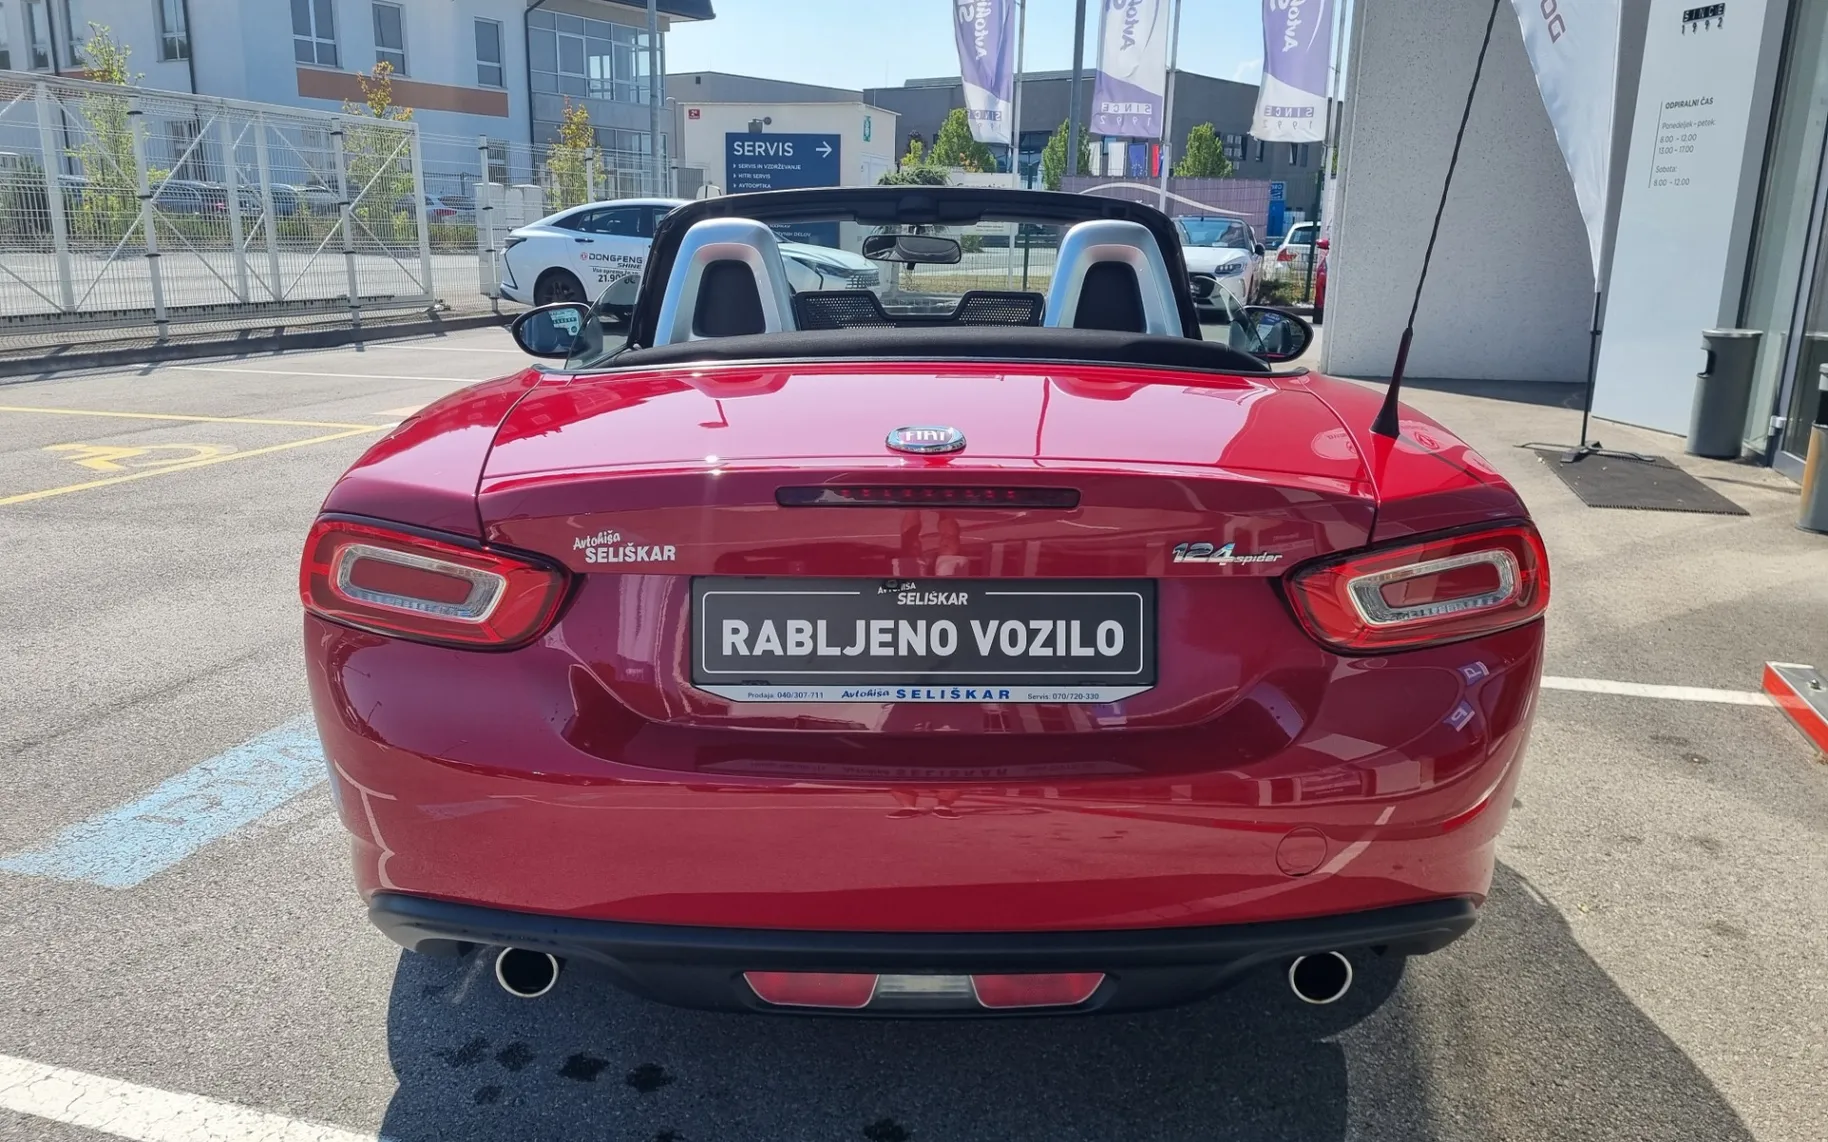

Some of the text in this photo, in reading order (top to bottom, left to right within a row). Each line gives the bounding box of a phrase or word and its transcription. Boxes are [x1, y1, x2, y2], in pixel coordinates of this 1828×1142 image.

[1683, 3, 1725, 22] SINCE
[1682, 17, 1723, 35] 1992
[1665, 96, 1714, 109] ODPIRALNI ČAS
[733, 141, 794, 157] SERVIS
[764, 162, 802, 170] VZDRŽEVANJE
[588, 252, 643, 264] DONGFENG
[905, 430, 946, 441] FIAT
[585, 542, 676, 563] SELIŠKAR
[1172, 542, 1283, 566] 124 spider
[897, 591, 969, 605] SELIŠKAR
[721, 618, 1125, 658] RABLJENO VOZILO
[776, 691, 824, 699] 040/307-711
[841, 687, 890, 699] Avtohiša
[896, 687, 1010, 700] SELIŠKAR
[1027, 692, 1051, 700] Servis:
[1052, 692, 1100, 700] 070/720-330
